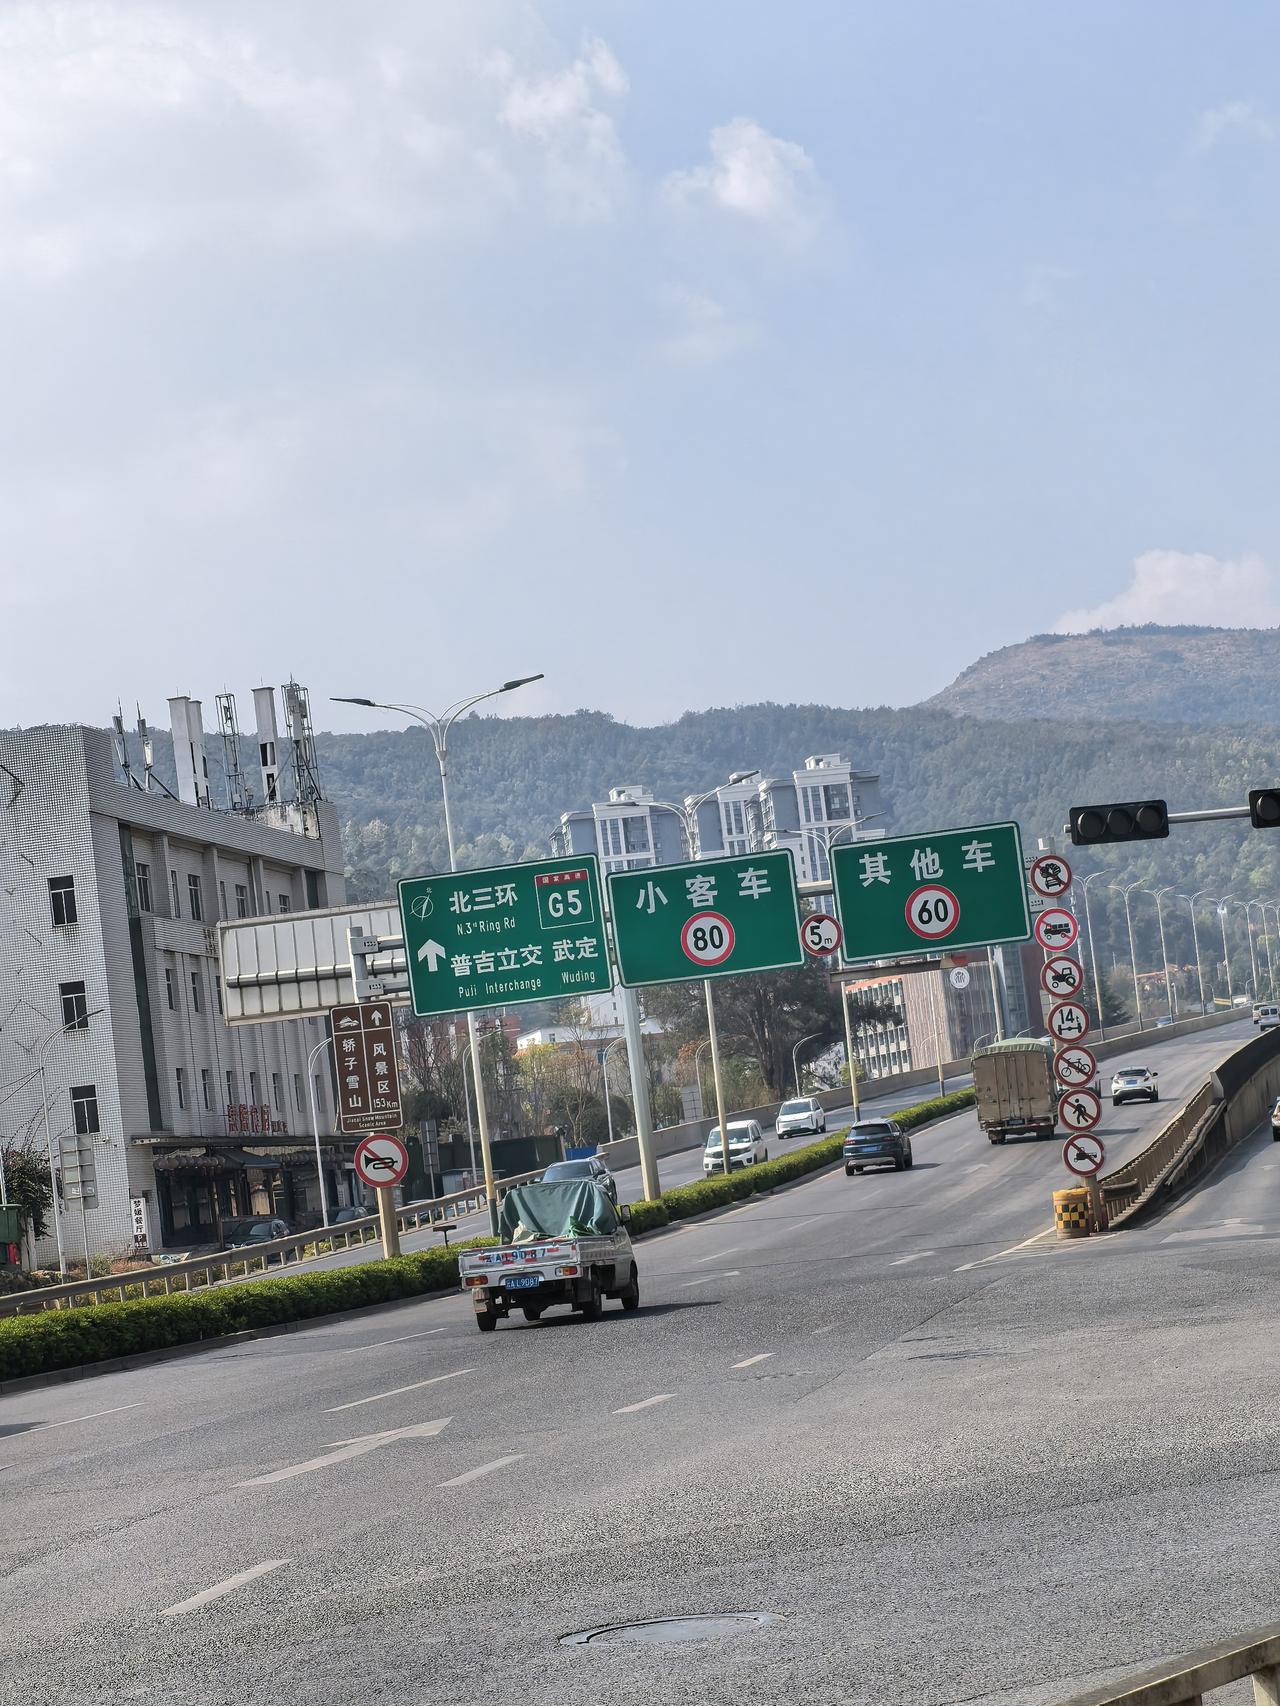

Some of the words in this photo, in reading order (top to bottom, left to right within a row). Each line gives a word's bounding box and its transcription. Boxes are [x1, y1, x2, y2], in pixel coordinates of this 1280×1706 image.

[859, 840, 996, 887] 其他车
[449, 883, 518, 913] 北三环
[549, 890, 583, 918] G5
[636, 867, 772, 913] 小客车
[479, 919, 500, 933] Ring
[504, 917, 516, 929] Rd
[918, 898, 948, 925] 60
[692, 925, 724, 951] 80
[450, 944, 543, 977] 普吉立交
[552, 937, 599, 962] 武定
[459, 986, 478, 998] Puji
[485, 977, 542, 994] Interchange
[561, 971, 596, 984] Wuding
[342, 1038, 362, 1108] 轿子雪山
[373, 1043, 391, 1094] 风景区
